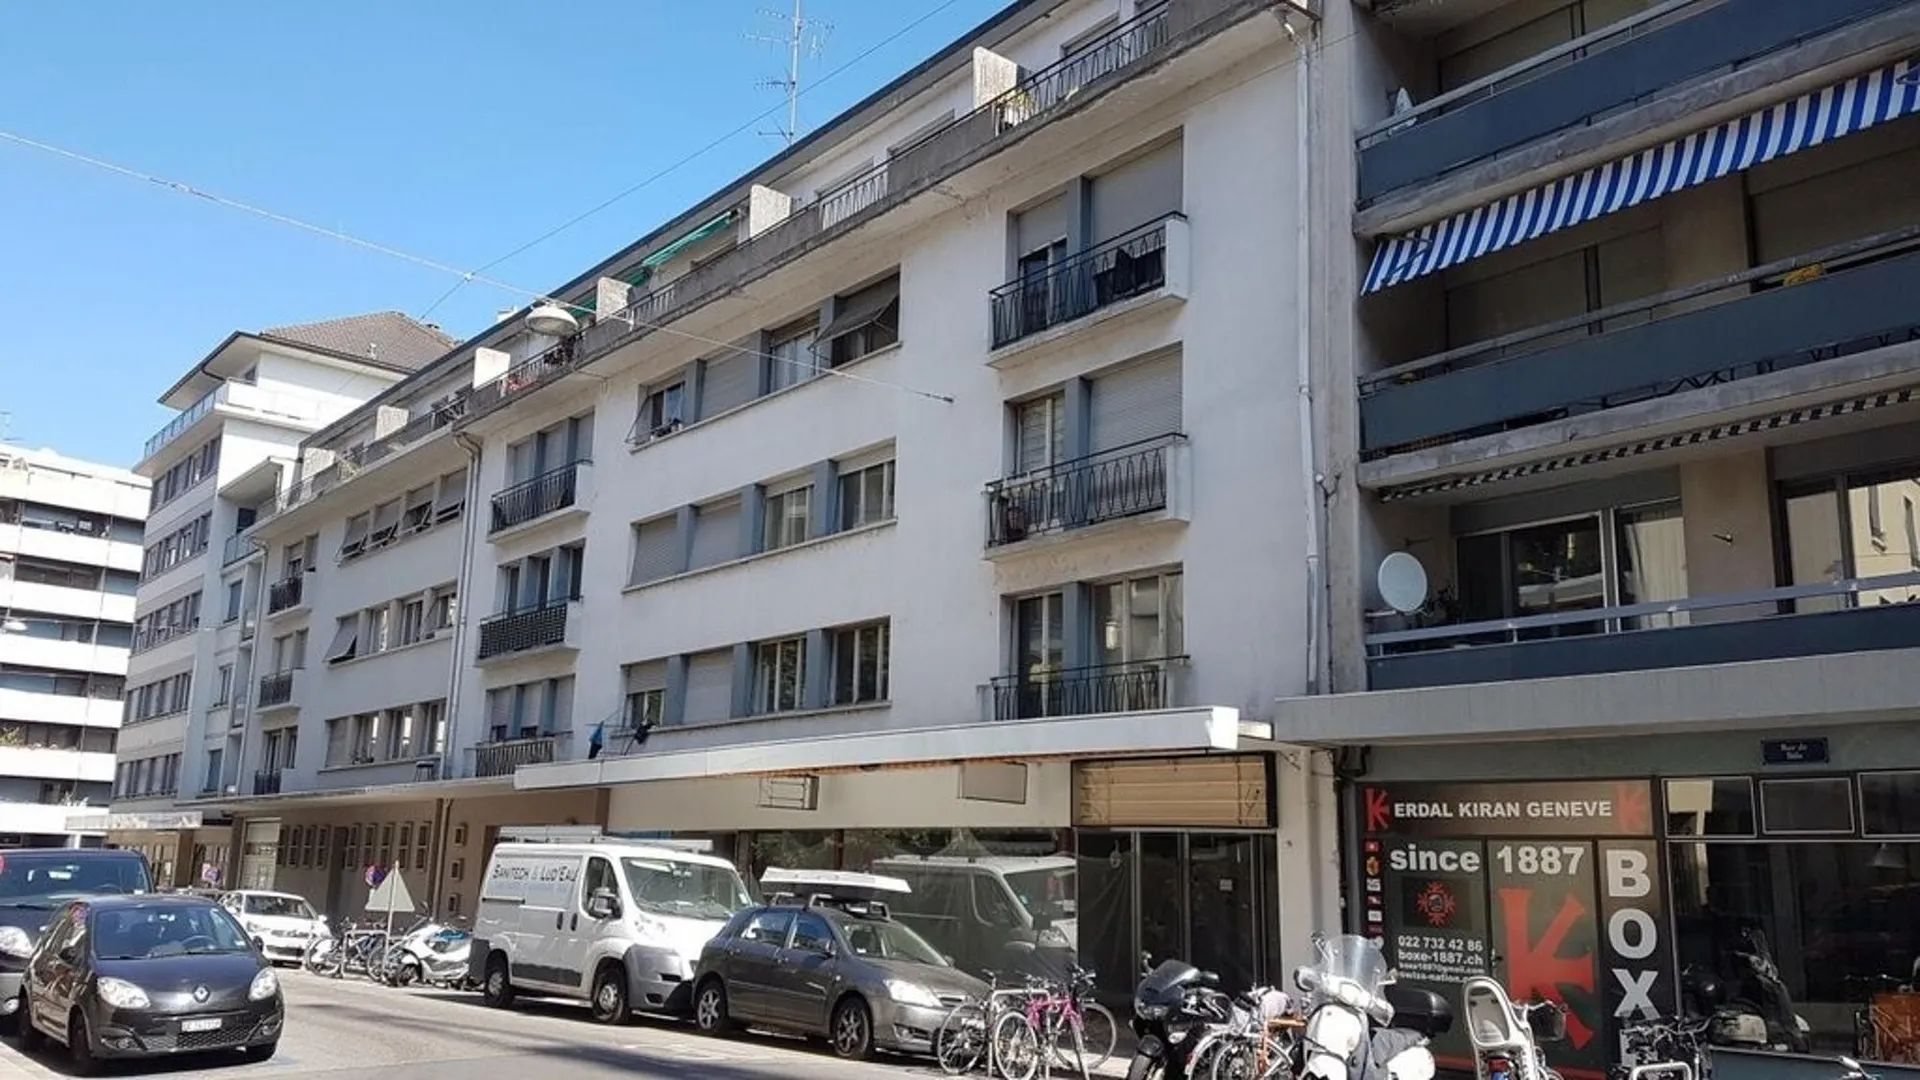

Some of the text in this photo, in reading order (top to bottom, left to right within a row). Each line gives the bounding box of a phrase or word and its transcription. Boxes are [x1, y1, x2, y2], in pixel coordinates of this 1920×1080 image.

[1394, 801, 1613, 818] ERDAL KIRAN GENEVE
[1390, 843, 1585, 875] since 1887
[1398, 935, 1420, 948] 022
[1422, 936, 1446, 950] 732
[1448, 938, 1464, 951] 42
